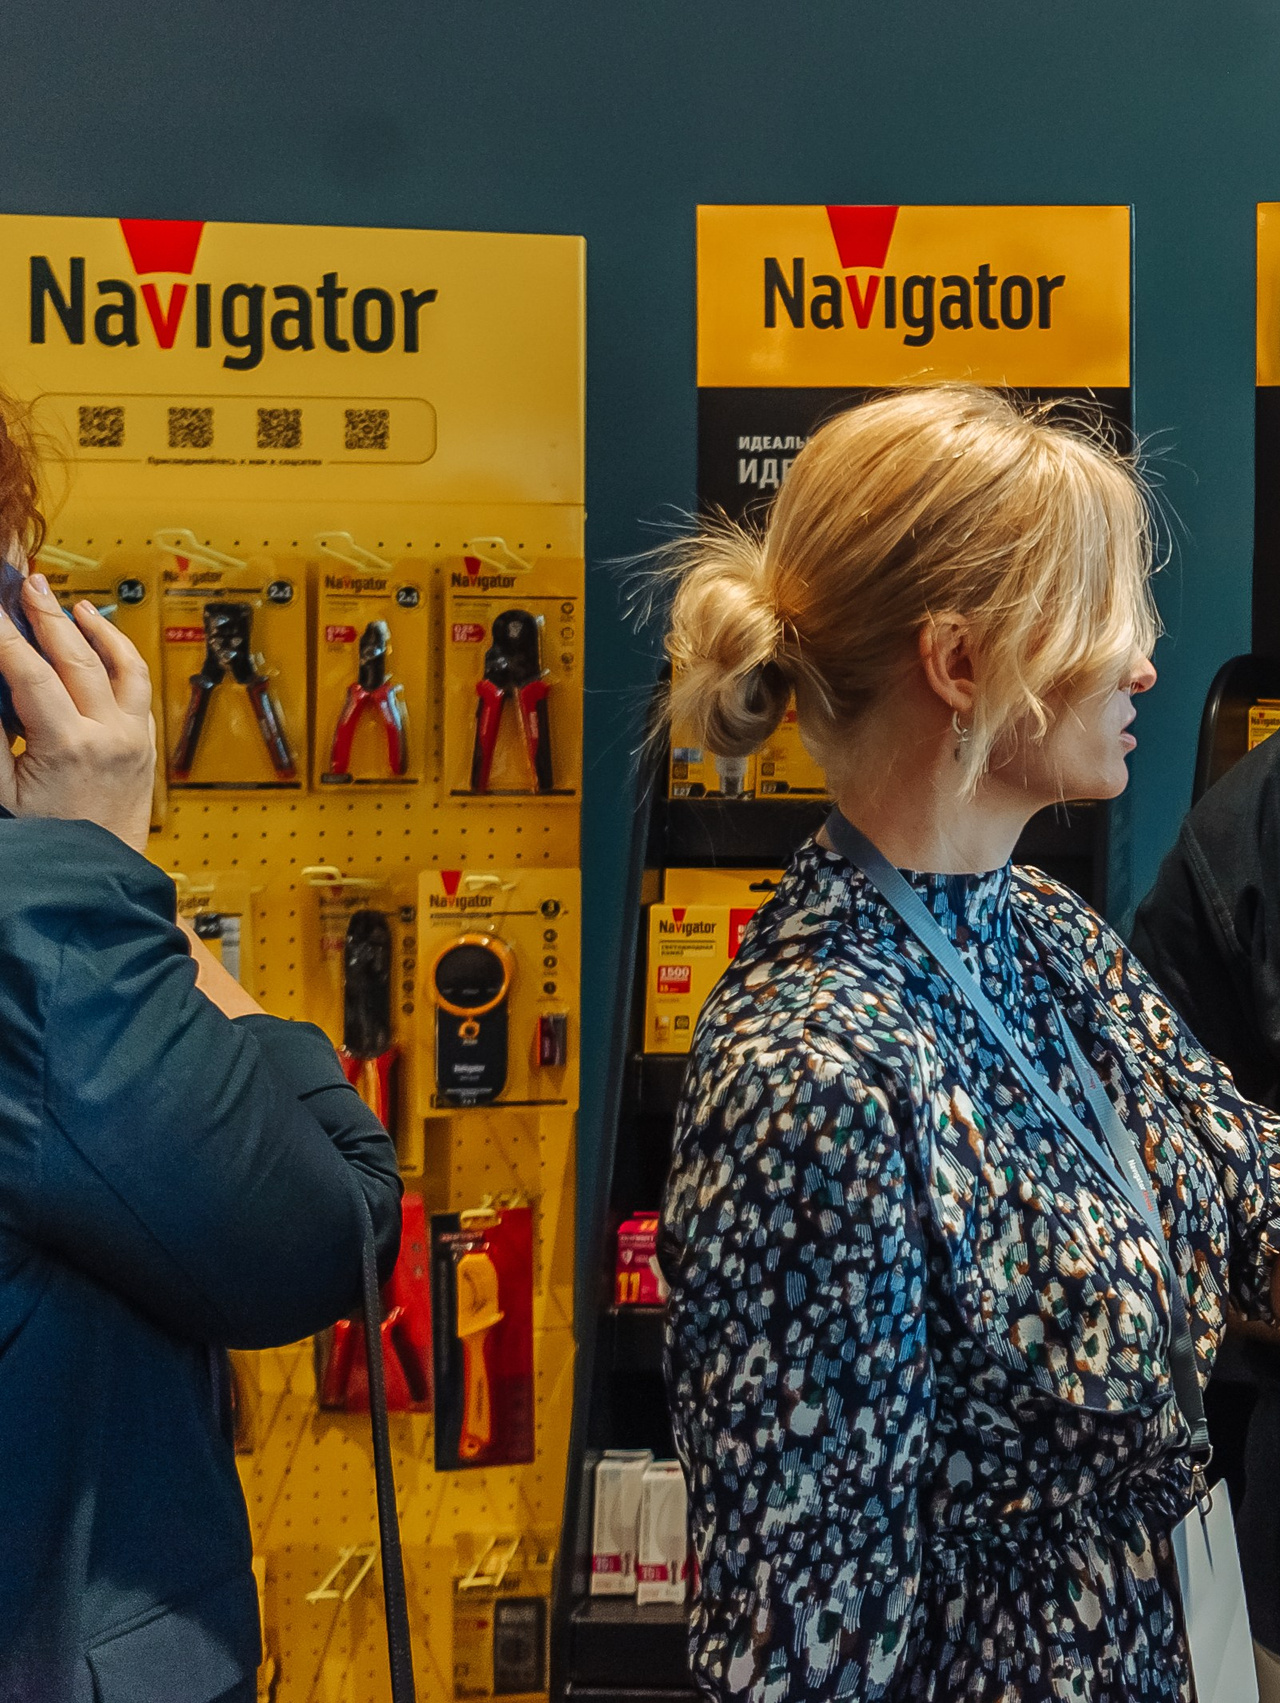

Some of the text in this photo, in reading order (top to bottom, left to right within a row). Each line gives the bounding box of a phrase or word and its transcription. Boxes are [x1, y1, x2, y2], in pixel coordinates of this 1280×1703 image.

[30, 255, 438, 371] Navigator
[764, 257, 1066, 347] Navigator
[739, 436, 810, 452] ИДЕАЛЬ
[659, 920, 717, 937] Navigator
